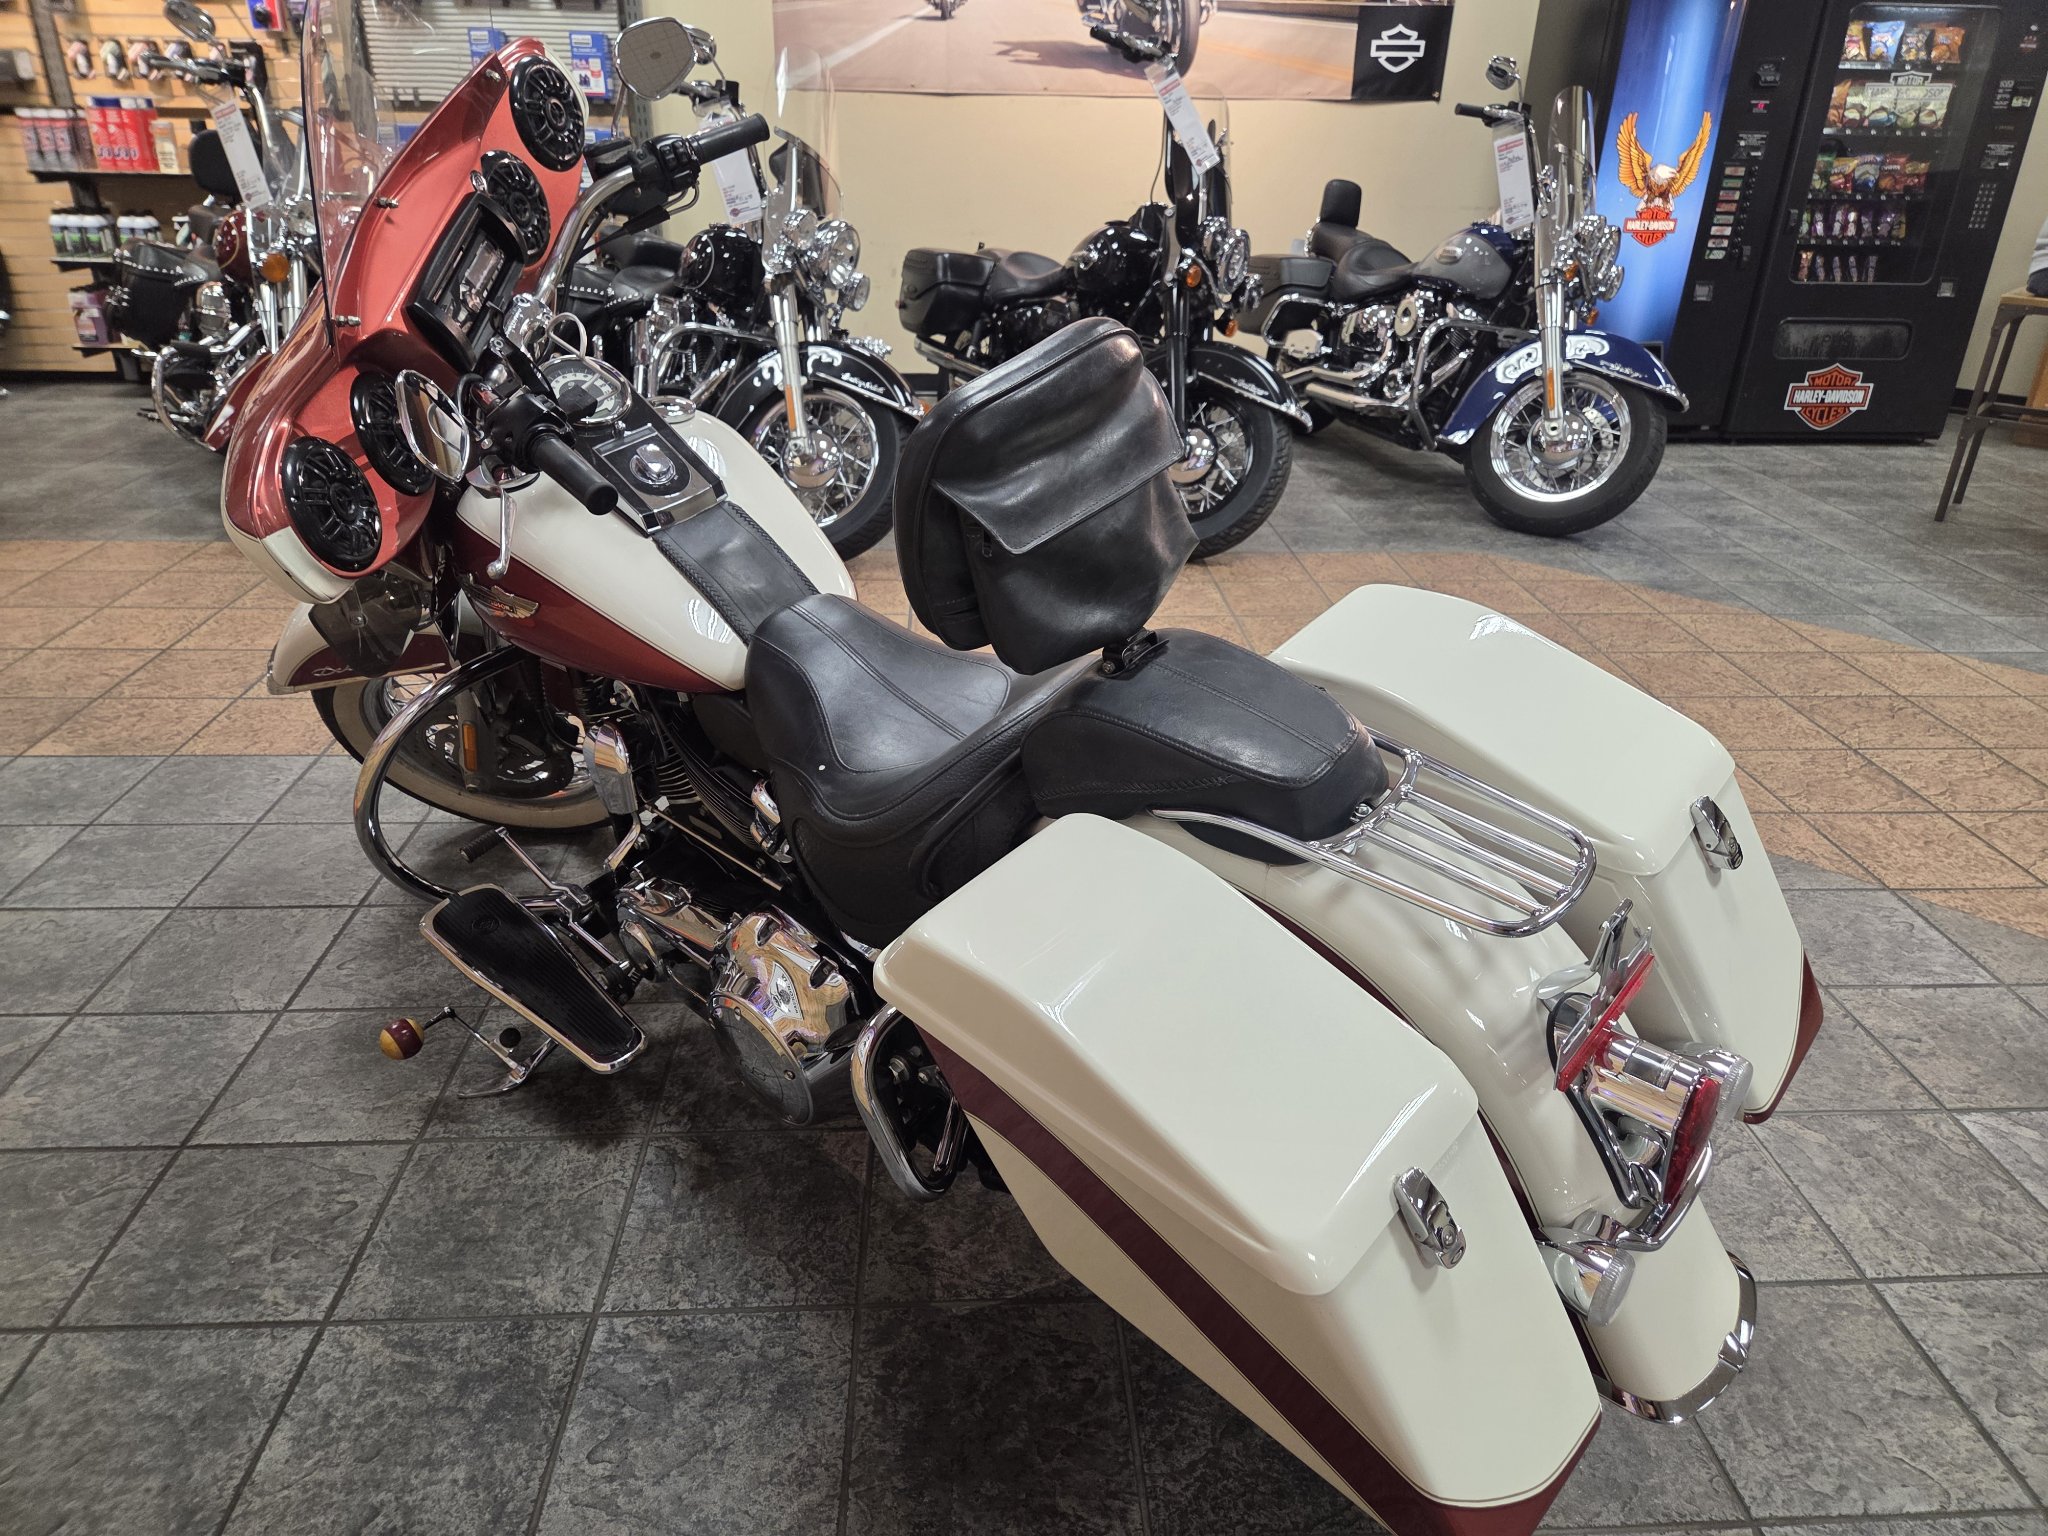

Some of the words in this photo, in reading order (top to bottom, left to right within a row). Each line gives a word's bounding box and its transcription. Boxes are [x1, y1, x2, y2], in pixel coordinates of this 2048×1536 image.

[1814, 371, 1852, 386] MOTOR
[1792, 389, 1865, 404] HARLEY-DAVIDSON
[1804, 406, 1846, 424] CYCLES
